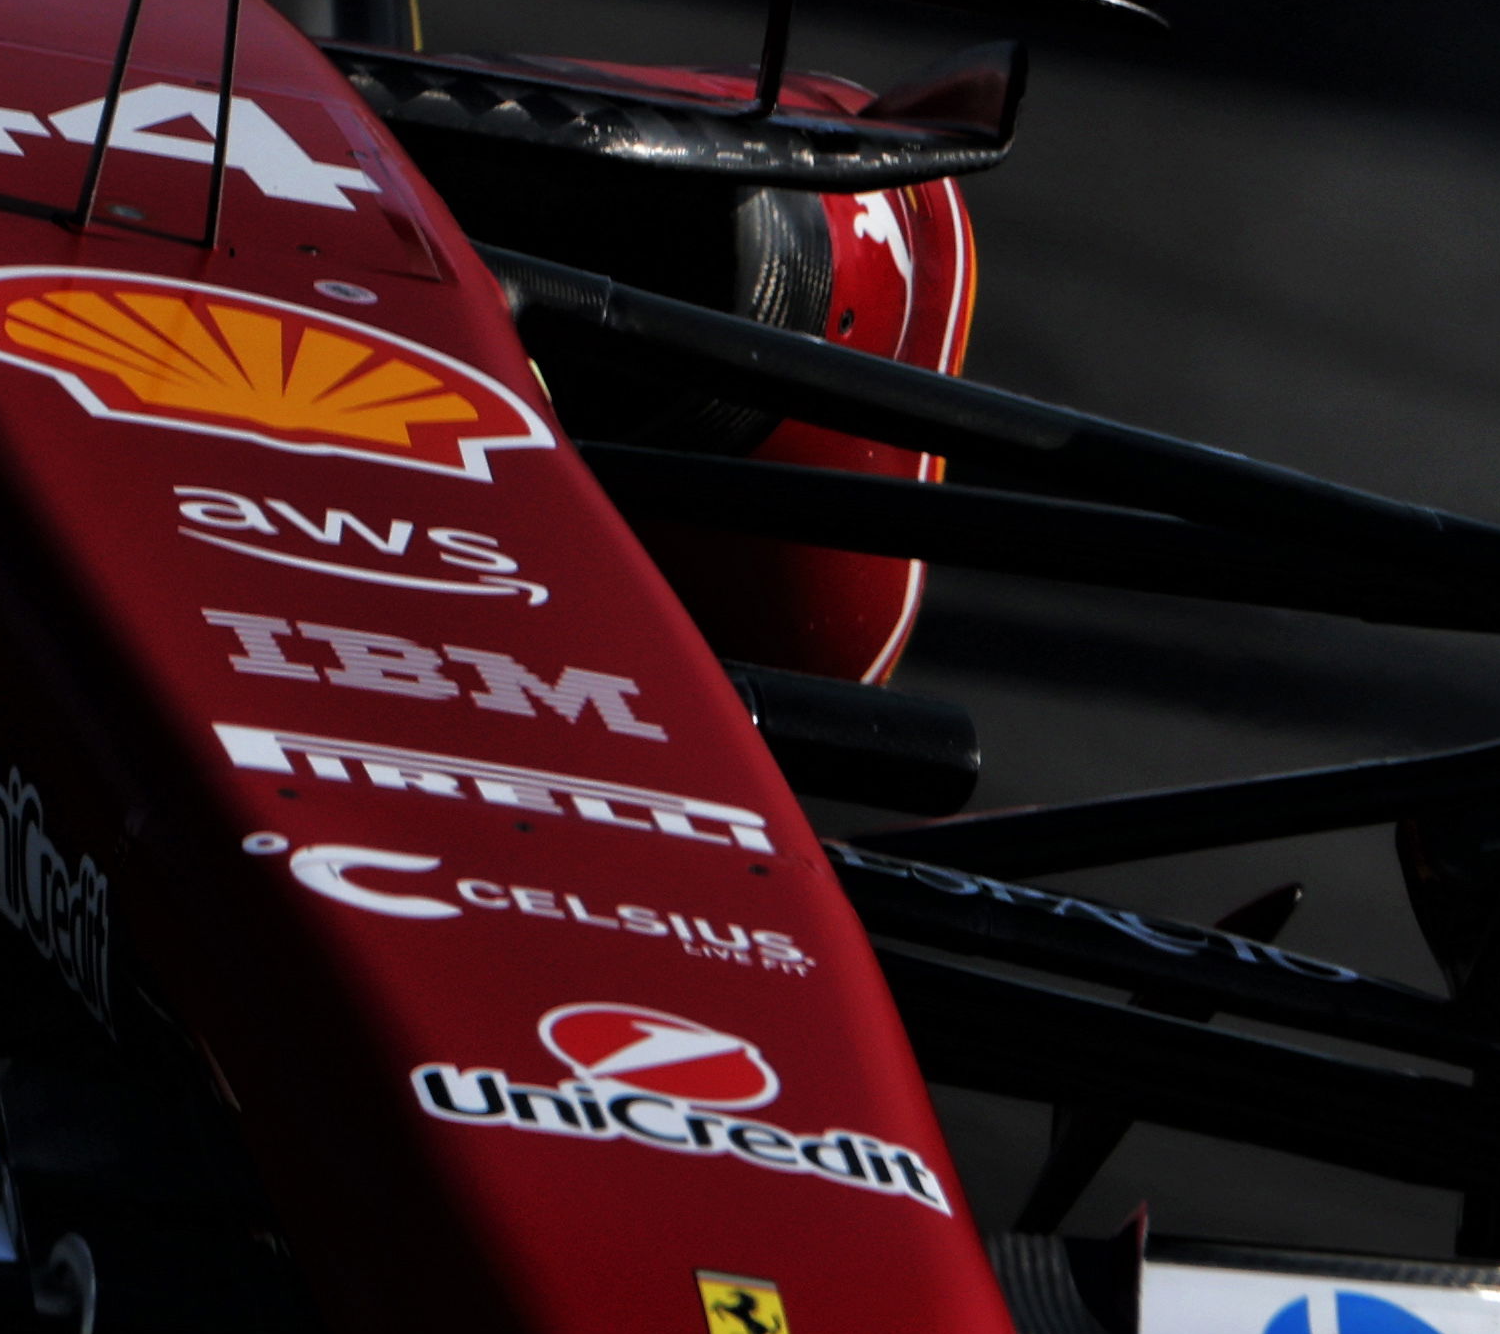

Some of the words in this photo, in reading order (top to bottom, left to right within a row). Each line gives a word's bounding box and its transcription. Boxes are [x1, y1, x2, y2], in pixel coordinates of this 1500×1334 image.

[173, 484, 520, 576] aws
[200, 607, 670, 743] IBM
[210, 721, 779, 855] PIRELLI
[682, 941, 753, 967] LIVE
[415, 1064, 946, 1211] UniCredit
